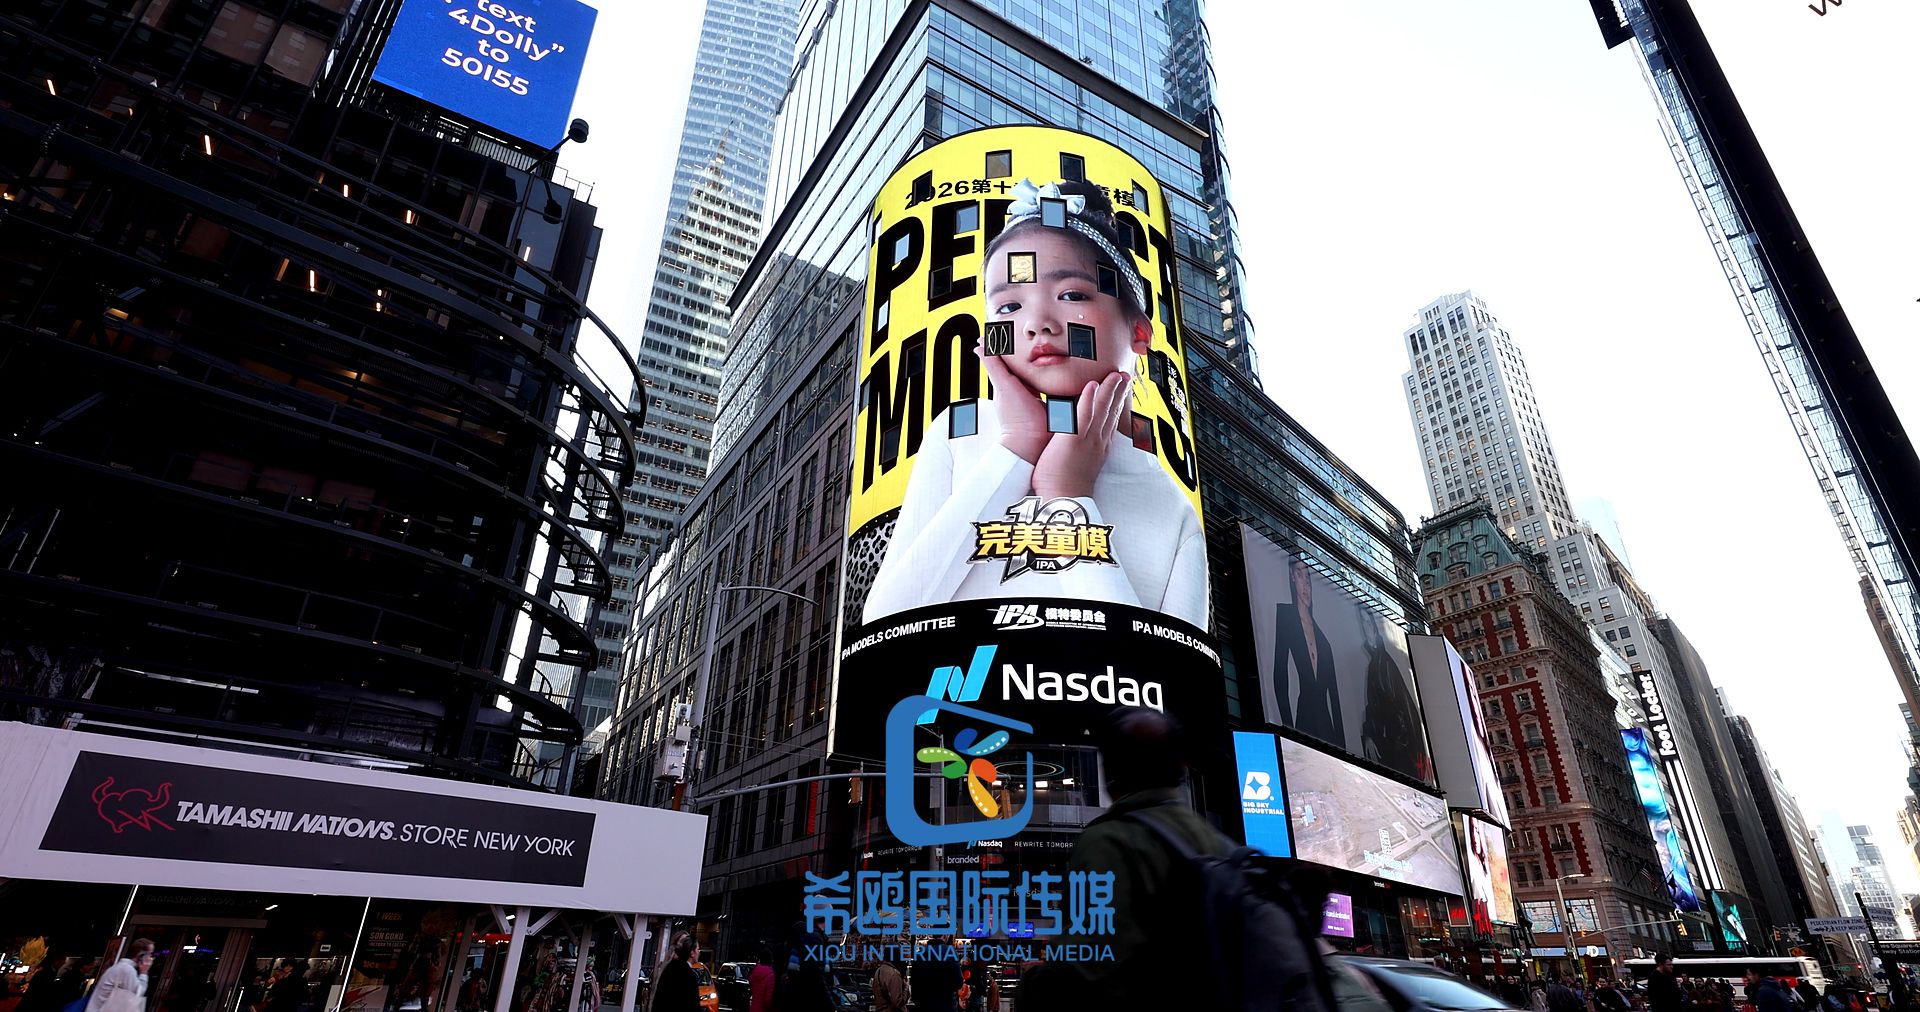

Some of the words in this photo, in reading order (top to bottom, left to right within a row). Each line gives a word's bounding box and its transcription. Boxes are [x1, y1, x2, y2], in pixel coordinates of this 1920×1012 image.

[477, 0, 537, 33] text
[478, 39, 509, 63] to
[441, 47, 530, 96] 50155
[977, 523, 1110, 559] 完美童模
[1036, 560, 1056, 570] IPA
[993, 604, 1039, 625] IPA
[1045, 608, 1106, 623] 模特委员会
[851, 632, 883, 654] MODELS
[885, 616, 956, 640] COMMITTEE
[1133, 620, 1152, 634] IPA
[1154, 625, 1193, 647] MODELS
[1002, 663, 1164, 713] Nasdaq
[1639, 673, 1665, 721] Locker
[1653, 723, 1676, 756] Foot
[1243, 807, 1285, 816] INDUSTRIAL
[176, 801, 294, 832] TAMASHII
[292, 813, 396, 841] NATIONS
[400, 823, 469, 849] STORE
[473, 830, 521, 851] NEW
[524, 835, 576, 857] YORK
[978, 840, 1003, 848] Nasdaq
[1046, 841, 1074, 849] TOMORR
[947, 855, 980, 864] branded
